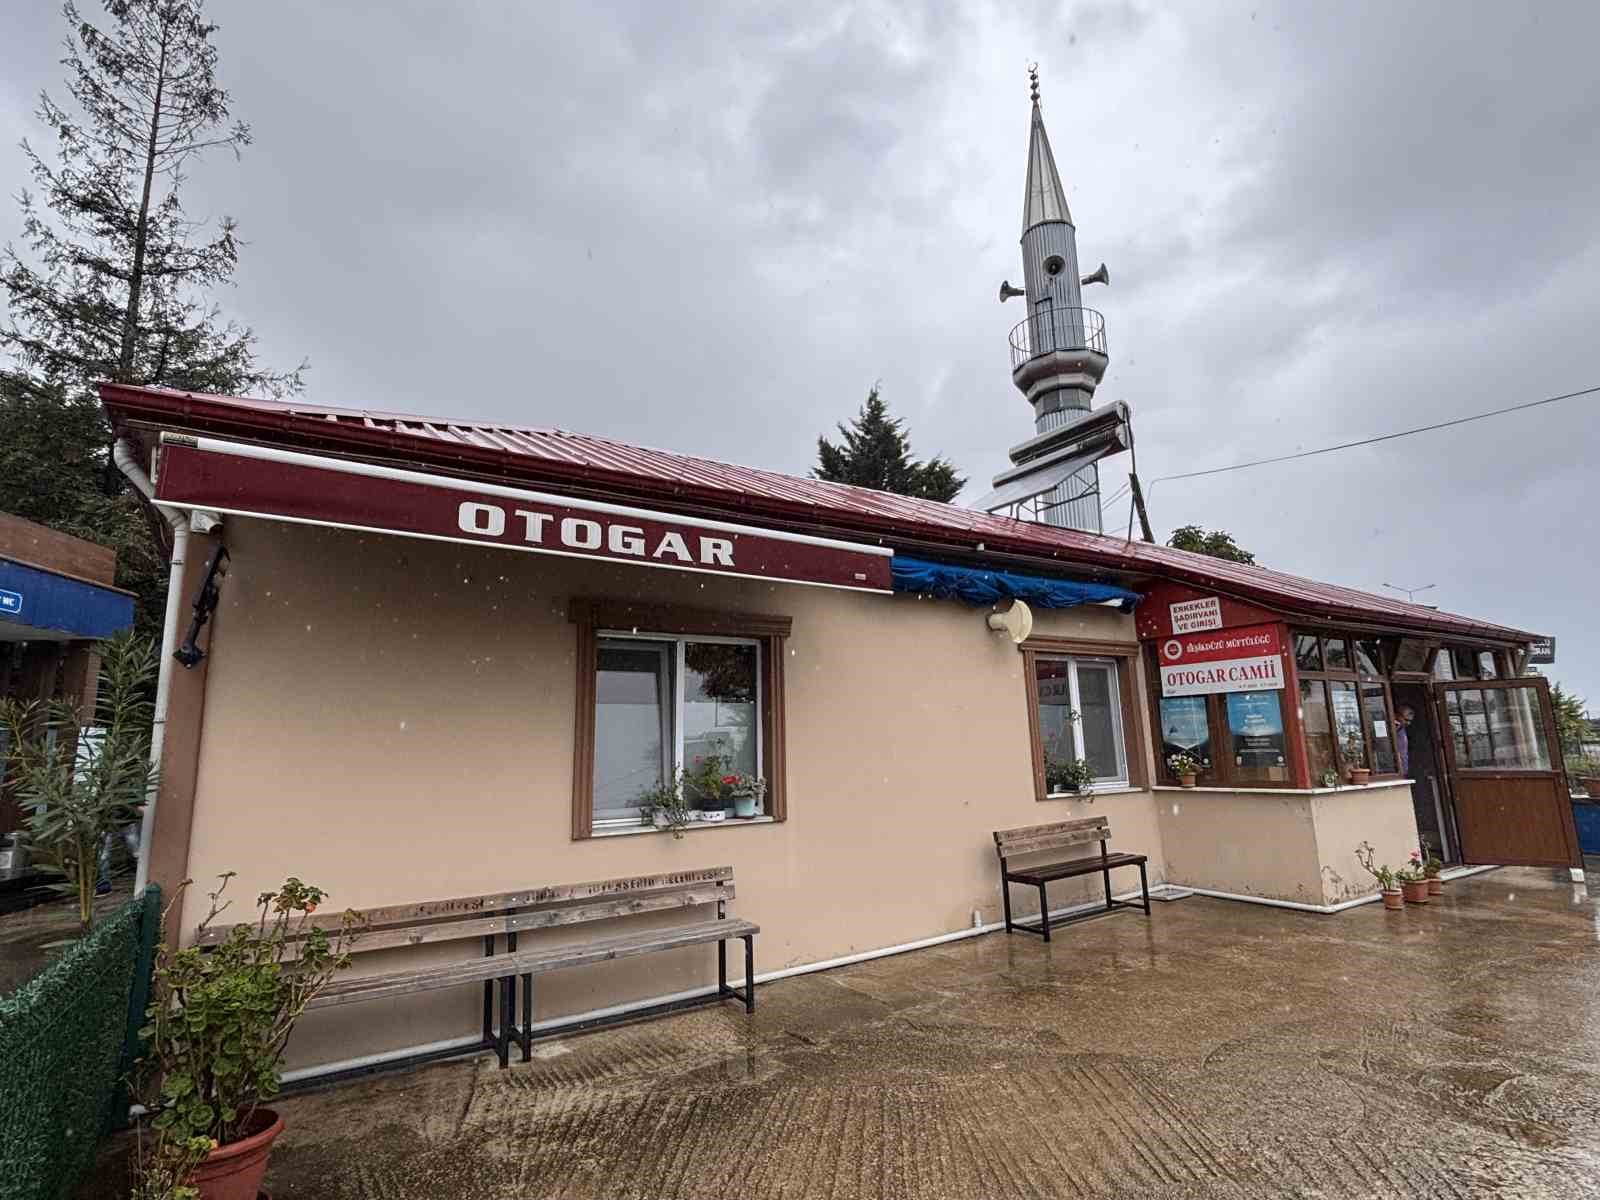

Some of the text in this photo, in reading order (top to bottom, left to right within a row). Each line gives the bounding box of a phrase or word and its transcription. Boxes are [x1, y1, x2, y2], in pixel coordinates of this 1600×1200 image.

[458, 501, 736, 567] OTOGAR
[1173, 601, 1216, 614] ERKEKLER
[1177, 621, 1191, 631] VE
[1167, 659, 1277, 687] OTOGAR CAMİİ
